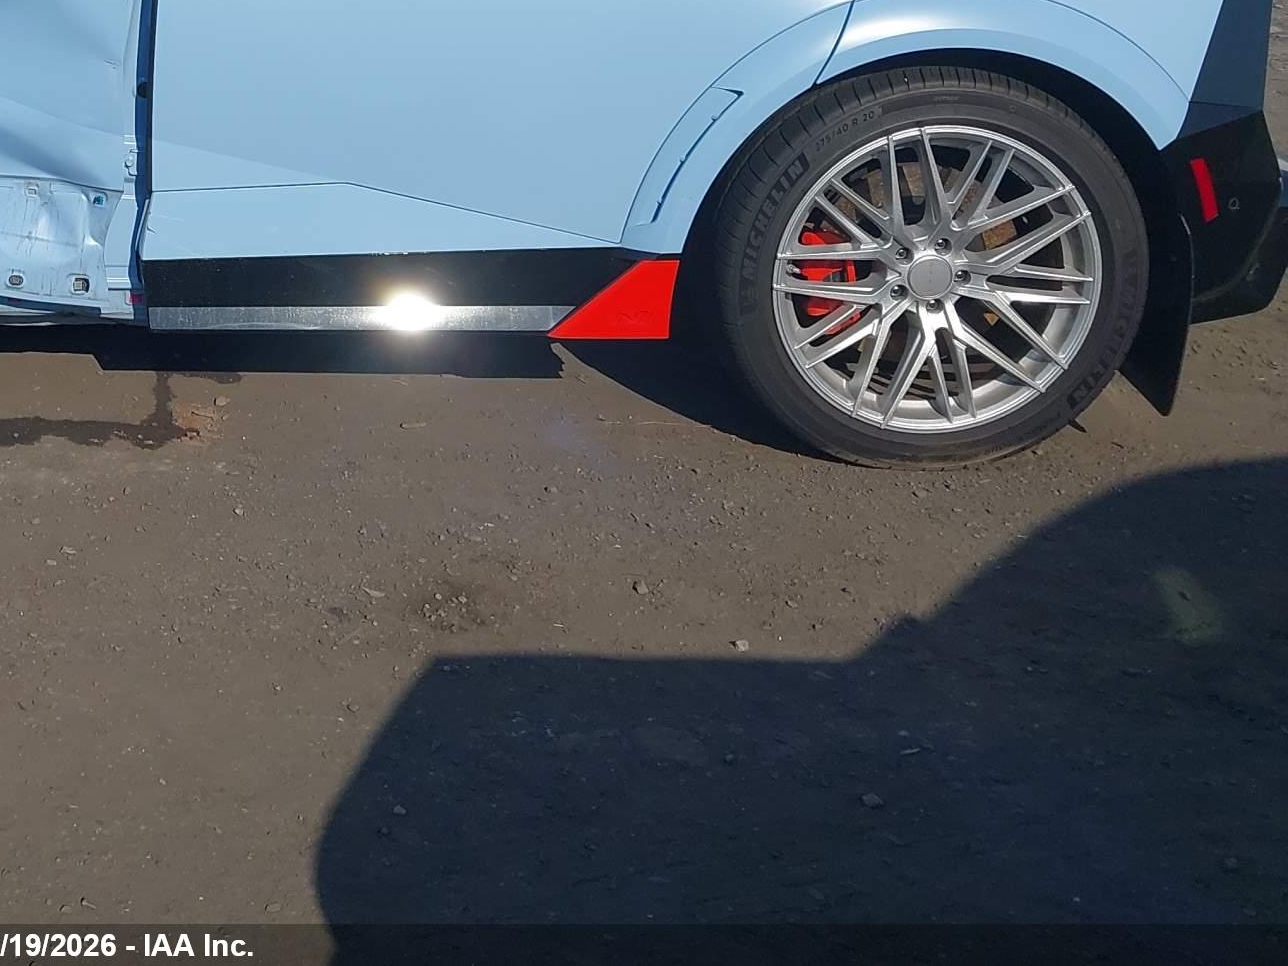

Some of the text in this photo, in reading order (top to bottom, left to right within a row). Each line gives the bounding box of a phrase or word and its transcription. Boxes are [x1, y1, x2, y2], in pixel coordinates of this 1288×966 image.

[851, 117, 859, 126] R
[862, 110, 875, 123] 20
[741, 158, 805, 282] MICHELIN
